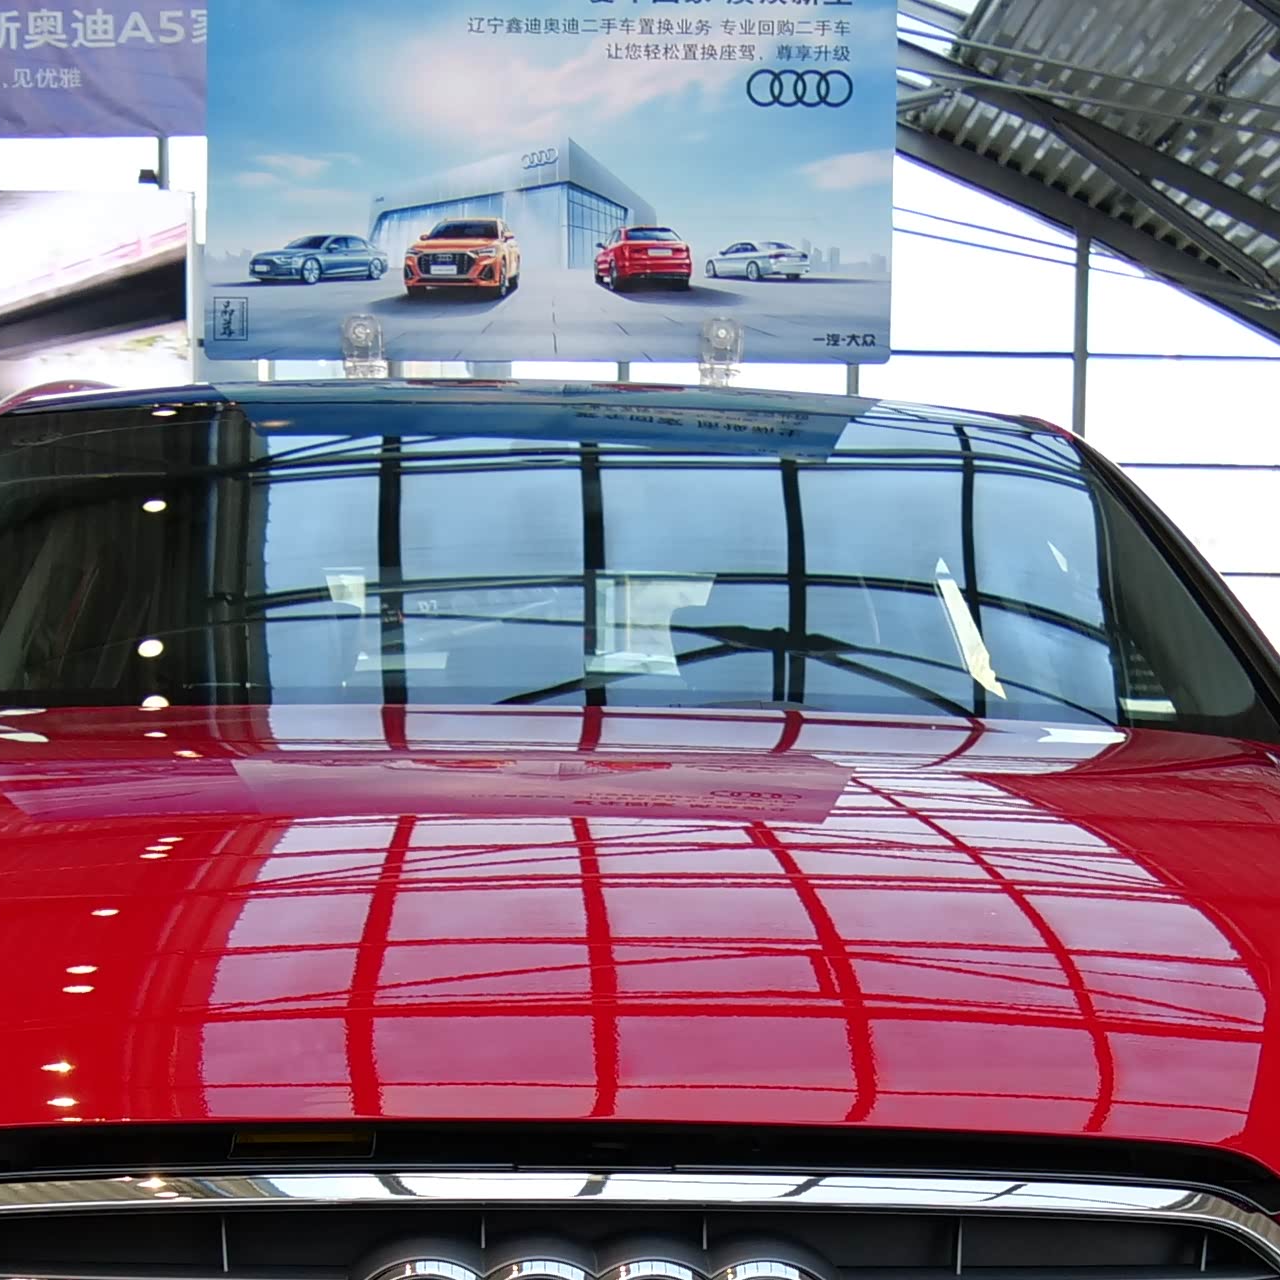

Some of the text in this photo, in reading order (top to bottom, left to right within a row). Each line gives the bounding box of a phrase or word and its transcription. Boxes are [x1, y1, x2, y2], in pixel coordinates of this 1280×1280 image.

[720, 19, 851, 36] 专业回购二手车
